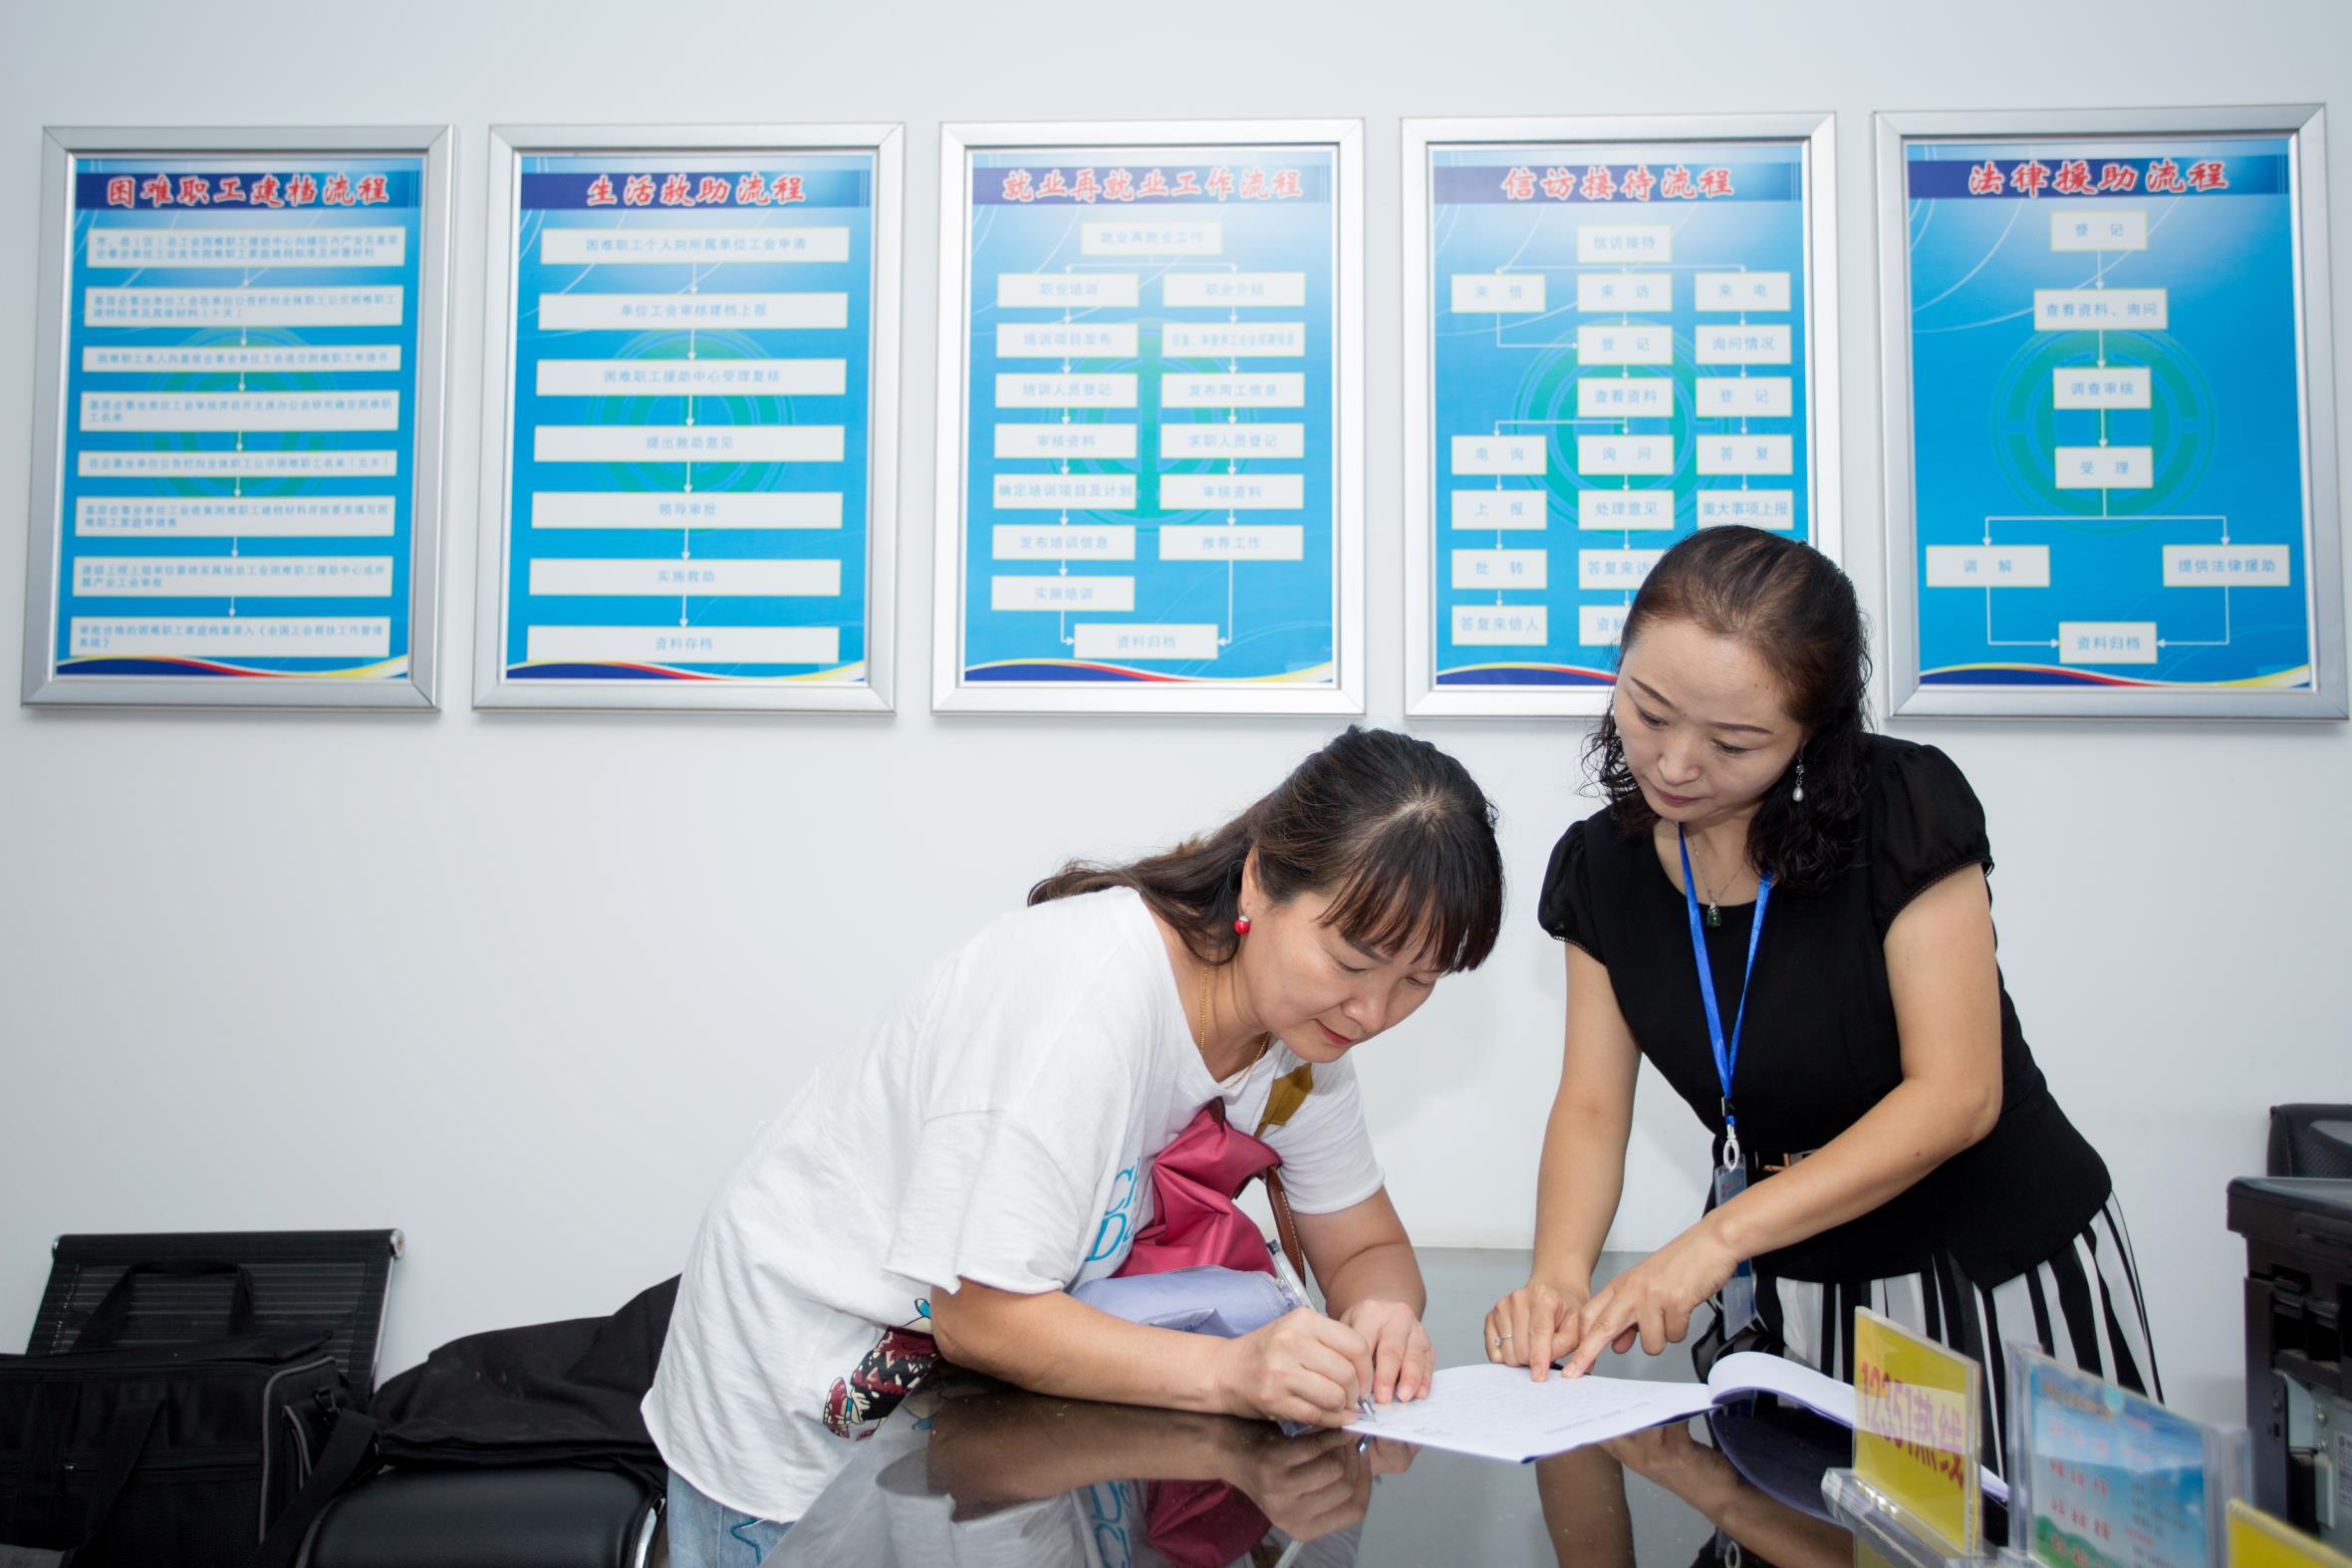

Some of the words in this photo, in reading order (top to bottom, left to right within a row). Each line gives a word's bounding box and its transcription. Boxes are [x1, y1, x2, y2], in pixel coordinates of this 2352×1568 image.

[106, 172, 390, 208] 困难职工建档流程
[586, 172, 807, 207] 生活救助流程
[1002, 167, 1303, 202] 就业再就业工作流程
[1501, 164, 1734, 201] 信访接待流程
[1968, 158, 2230, 197] 法律援助流程
